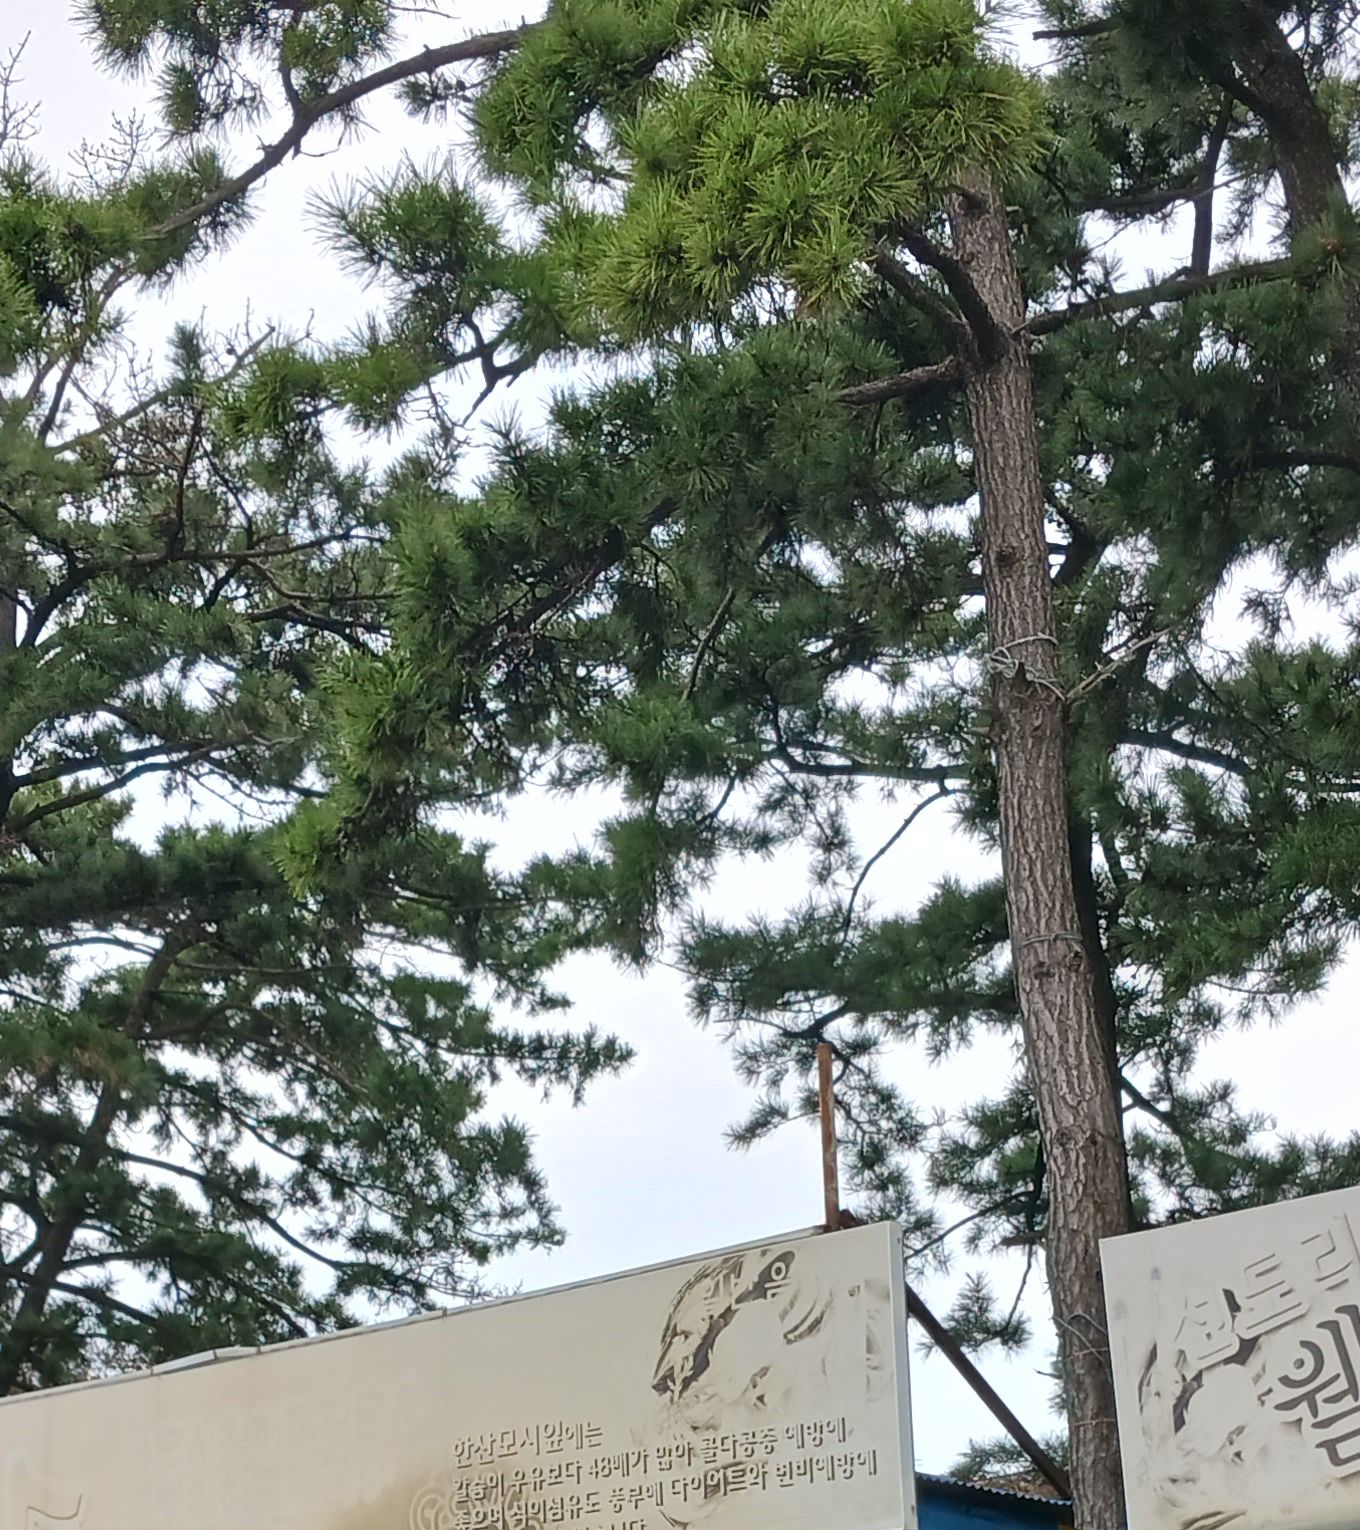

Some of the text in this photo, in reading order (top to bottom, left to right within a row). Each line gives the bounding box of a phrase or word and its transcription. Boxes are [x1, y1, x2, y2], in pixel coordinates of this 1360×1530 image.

[511, 1461, 583, 1494] 우유보다
[589, 1449, 650, 1480] 48배가
[700, 1428, 779, 1464] 골다공증
[785, 1417, 847, 1450] 예방에
[510, 1491, 602, 1528] 식이섬유도
[672, 1463, 769, 1502] 다이어트와
